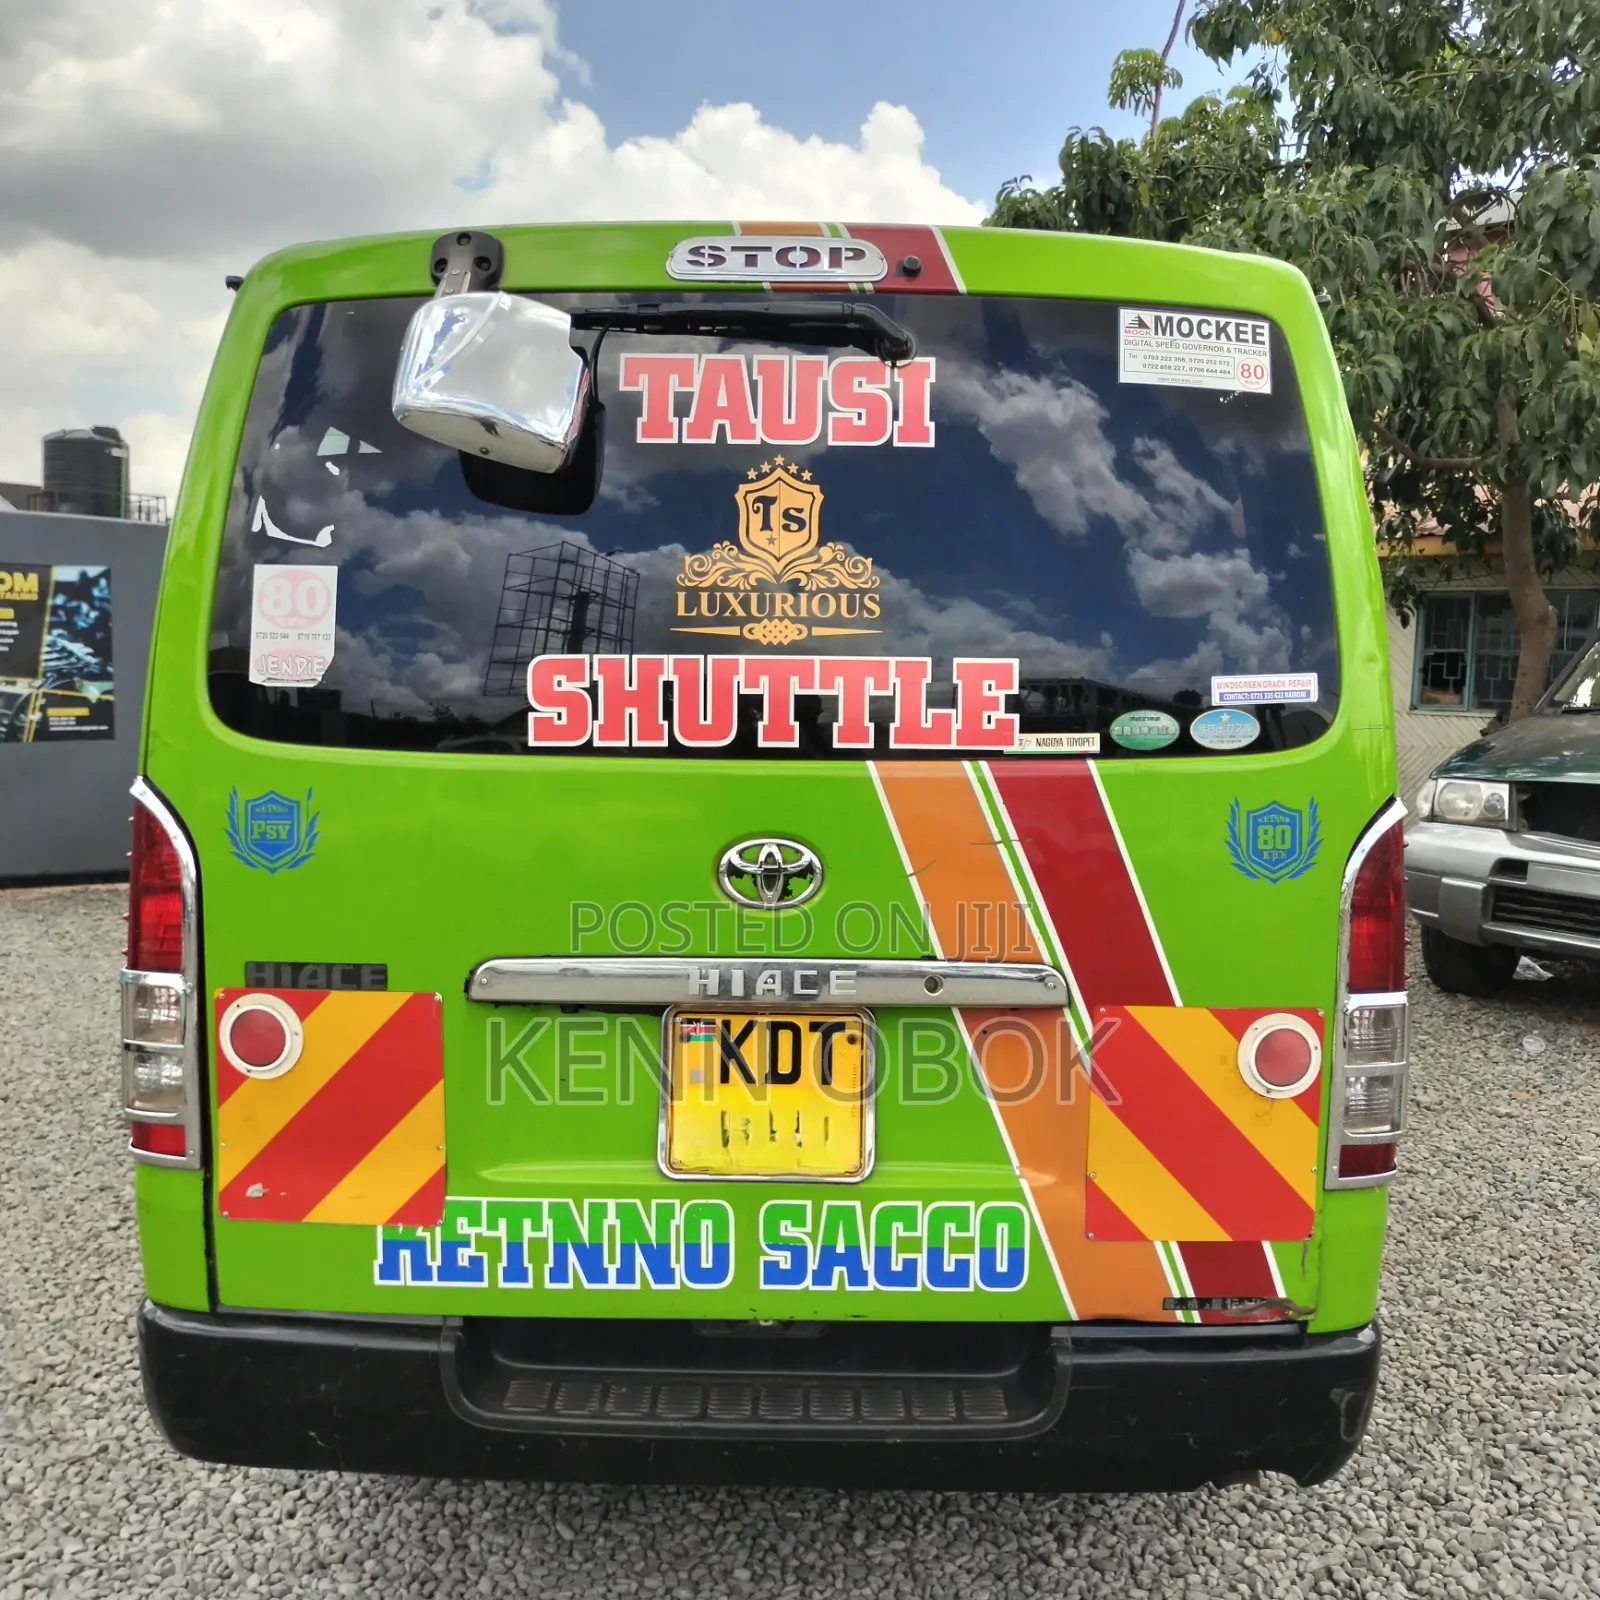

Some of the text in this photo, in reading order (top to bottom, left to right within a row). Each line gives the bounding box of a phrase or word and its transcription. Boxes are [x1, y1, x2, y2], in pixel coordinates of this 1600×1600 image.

[686, 245, 867, 269] STOP
[1154, 315, 1267, 346] MOCKEE
[1124, 339, 1153, 348] DIGITAL
[1155, 341, 1180, 350] SPEED
[1182, 343, 1225, 353] GOVERNOR
[1233, 347, 1268, 357] TRACKER
[1240, 363, 1265, 380] 80
[619, 353, 936, 447] TAUSI
[262, 578, 328, 617] 80
[676, 592, 881, 618] LUXURIOUS
[1216, 679, 1312, 690] WINDSCREEN CRACK REPAIR
[1223, 692, 1250, 700] CONTACT:
[1284, 690, 1307, 699] NAIROBI
[527, 654, 1020, 749] SHUTTLE
[1035, 737, 1064, 747] NAGOYA
[1066, 736, 1096, 747] TOYOPET
[1257, 825, 1291, 850] 80
[250, 964, 387, 990] HIACE
[688, 968, 857, 996] HIACE
[720, 1019, 846, 1086] KDT
[759, 1200, 1030, 1292] SACCO
